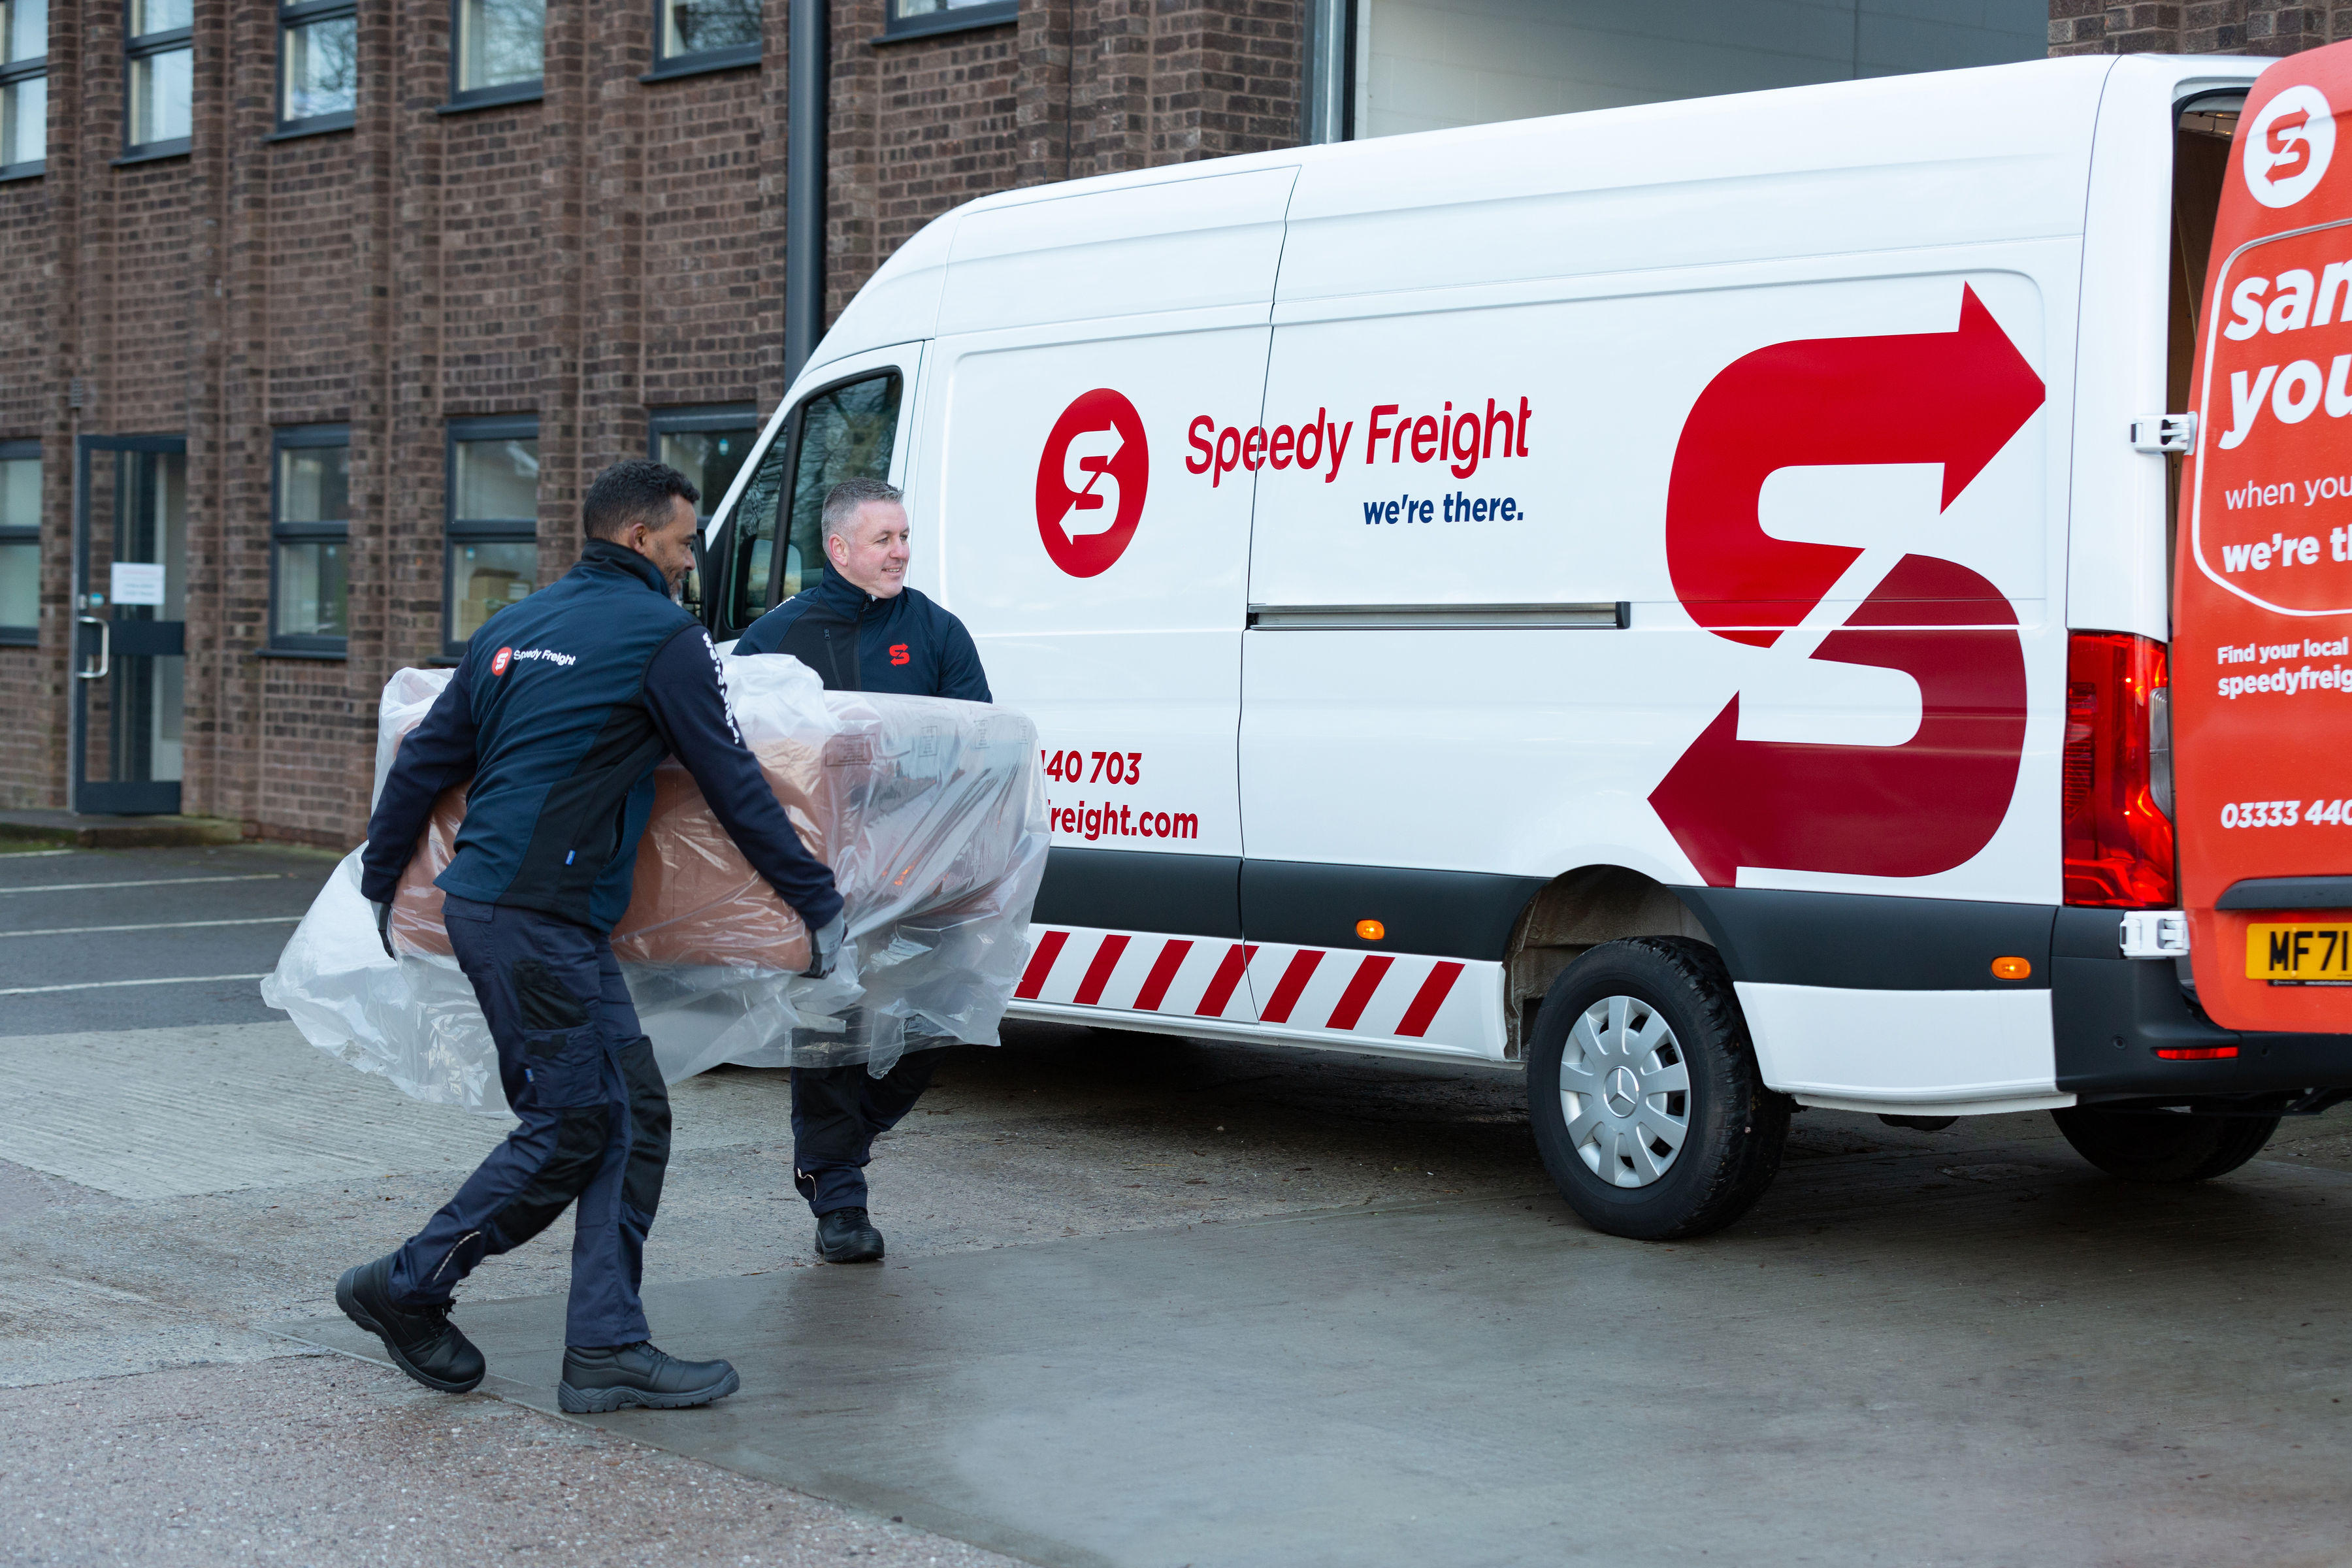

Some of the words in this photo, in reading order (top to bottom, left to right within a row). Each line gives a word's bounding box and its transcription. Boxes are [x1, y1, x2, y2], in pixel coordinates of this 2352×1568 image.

[1186, 406, 1354, 487] Speedy
[1366, 396, 1532, 479] Freight
[1364, 494, 1434, 525] we're
[1443, 491, 1524, 523] there.
[2225, 480, 2295, 510] when
[2222, 532, 2320, 572] we're
[541, 649, 576, 666] Freight
[2217, 643, 2255, 664] Find
[2259, 644, 2300, 664] your
[2304, 636, 2349, 657] local
[1089, 751, 1143, 785] 703
[1047, 798, 1199, 841] reight.com
[2221, 800, 2301, 829] 03333
[2268, 930, 2349, 972] MF71
